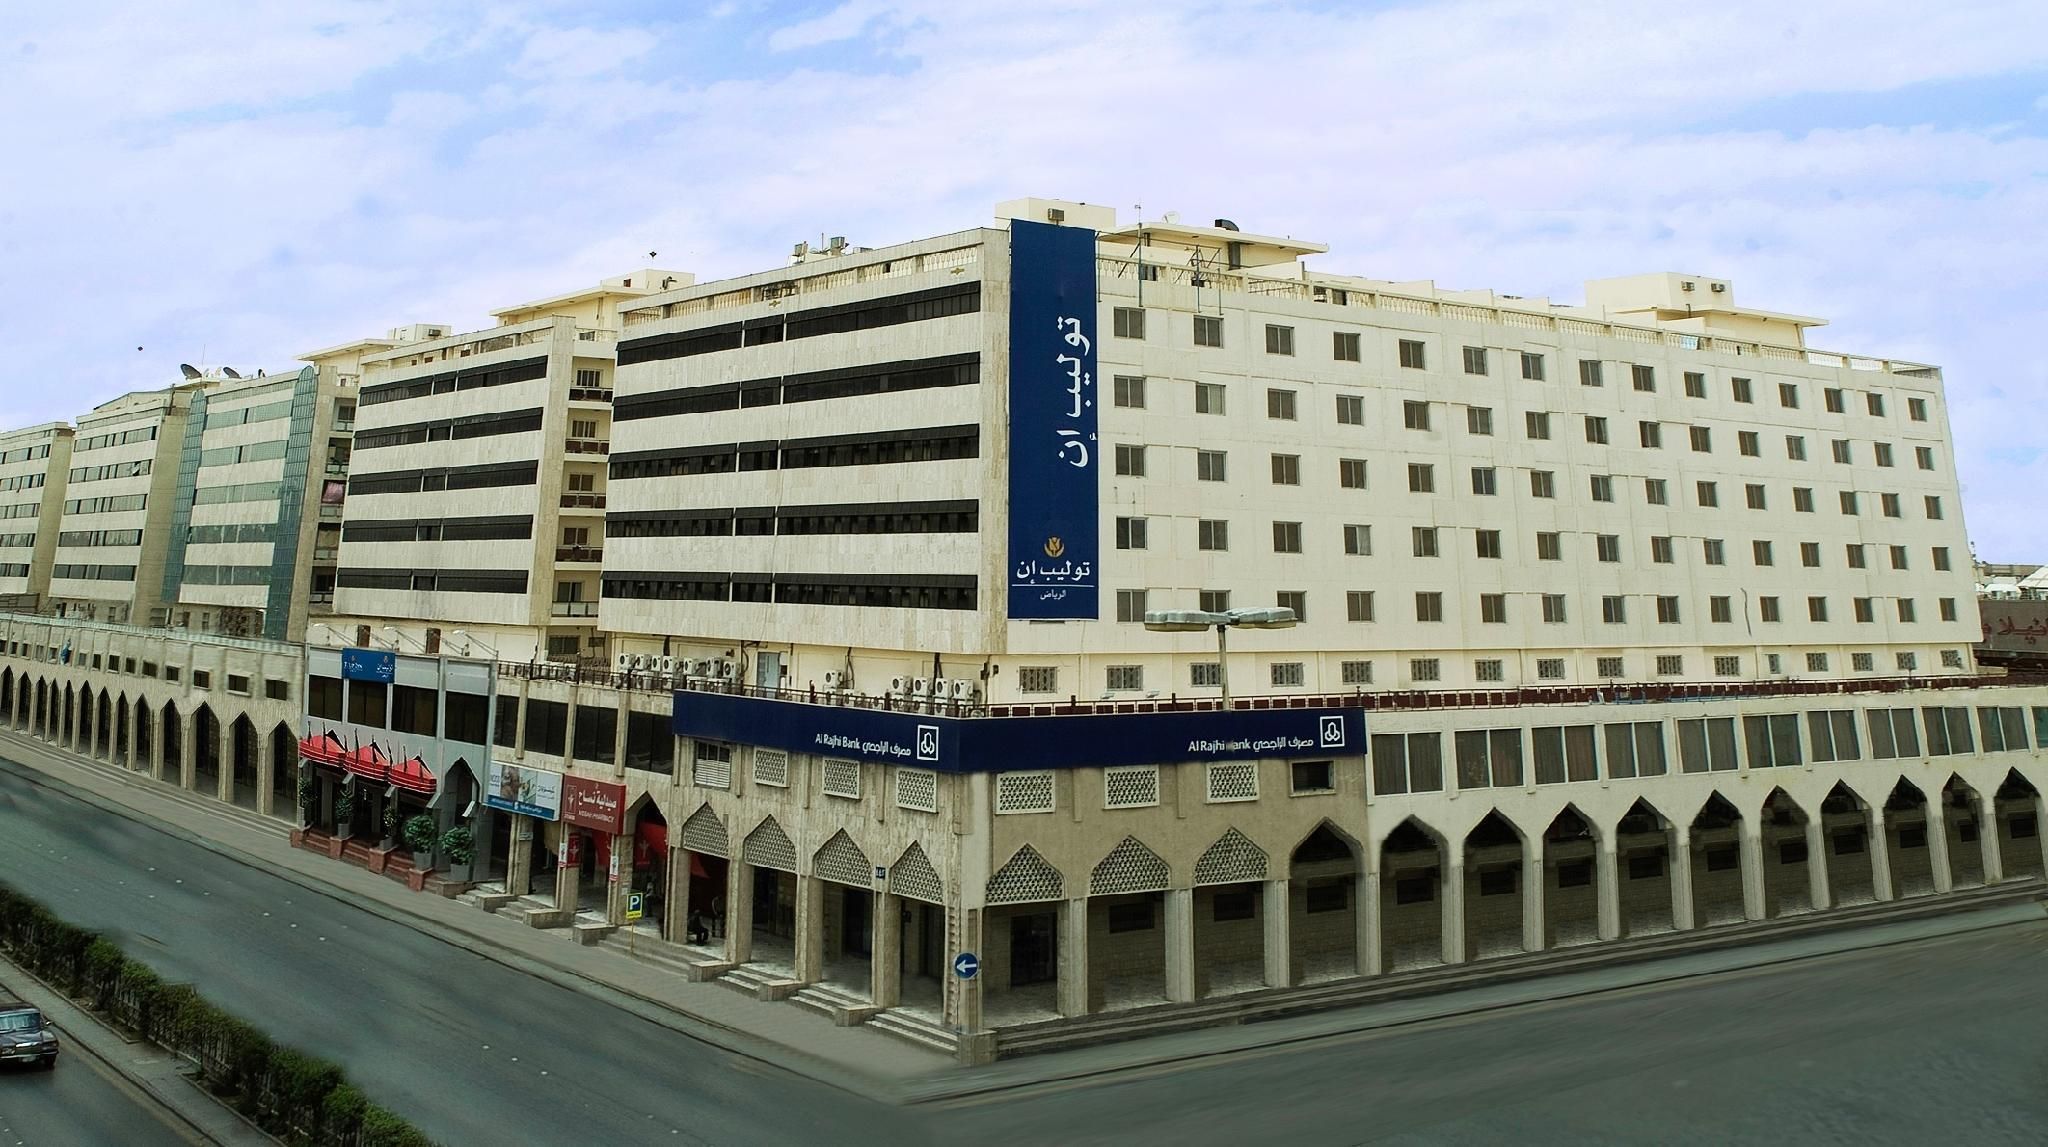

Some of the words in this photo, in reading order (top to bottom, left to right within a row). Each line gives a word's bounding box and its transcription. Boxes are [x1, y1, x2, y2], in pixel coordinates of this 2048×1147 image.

[1056, 316, 1091, 418] توليب
[1056, 429, 1097, 468] إن
[1016, 560, 1036, 584] إن
[1040, 560, 1091, 582] توليب
[1040, 589, 1067, 600] الرياض
[815, 733, 823, 744] Al
[823, 733, 842, 749] Rajhi
[842, 736, 861, 749] Bank
[862, 740, 889, 755] الراجحي
[1188, 740, 1199, 752] Al
[1200, 740, 1225, 754] Rajhi
[1226, 738, 1251, 752] ank
[1253, 736, 1286, 753] الراجحي
[1288, 736, 1314, 751] مصرف
[889, 743, 911, 757] مصرف
[629, 896, 640, 910] P
